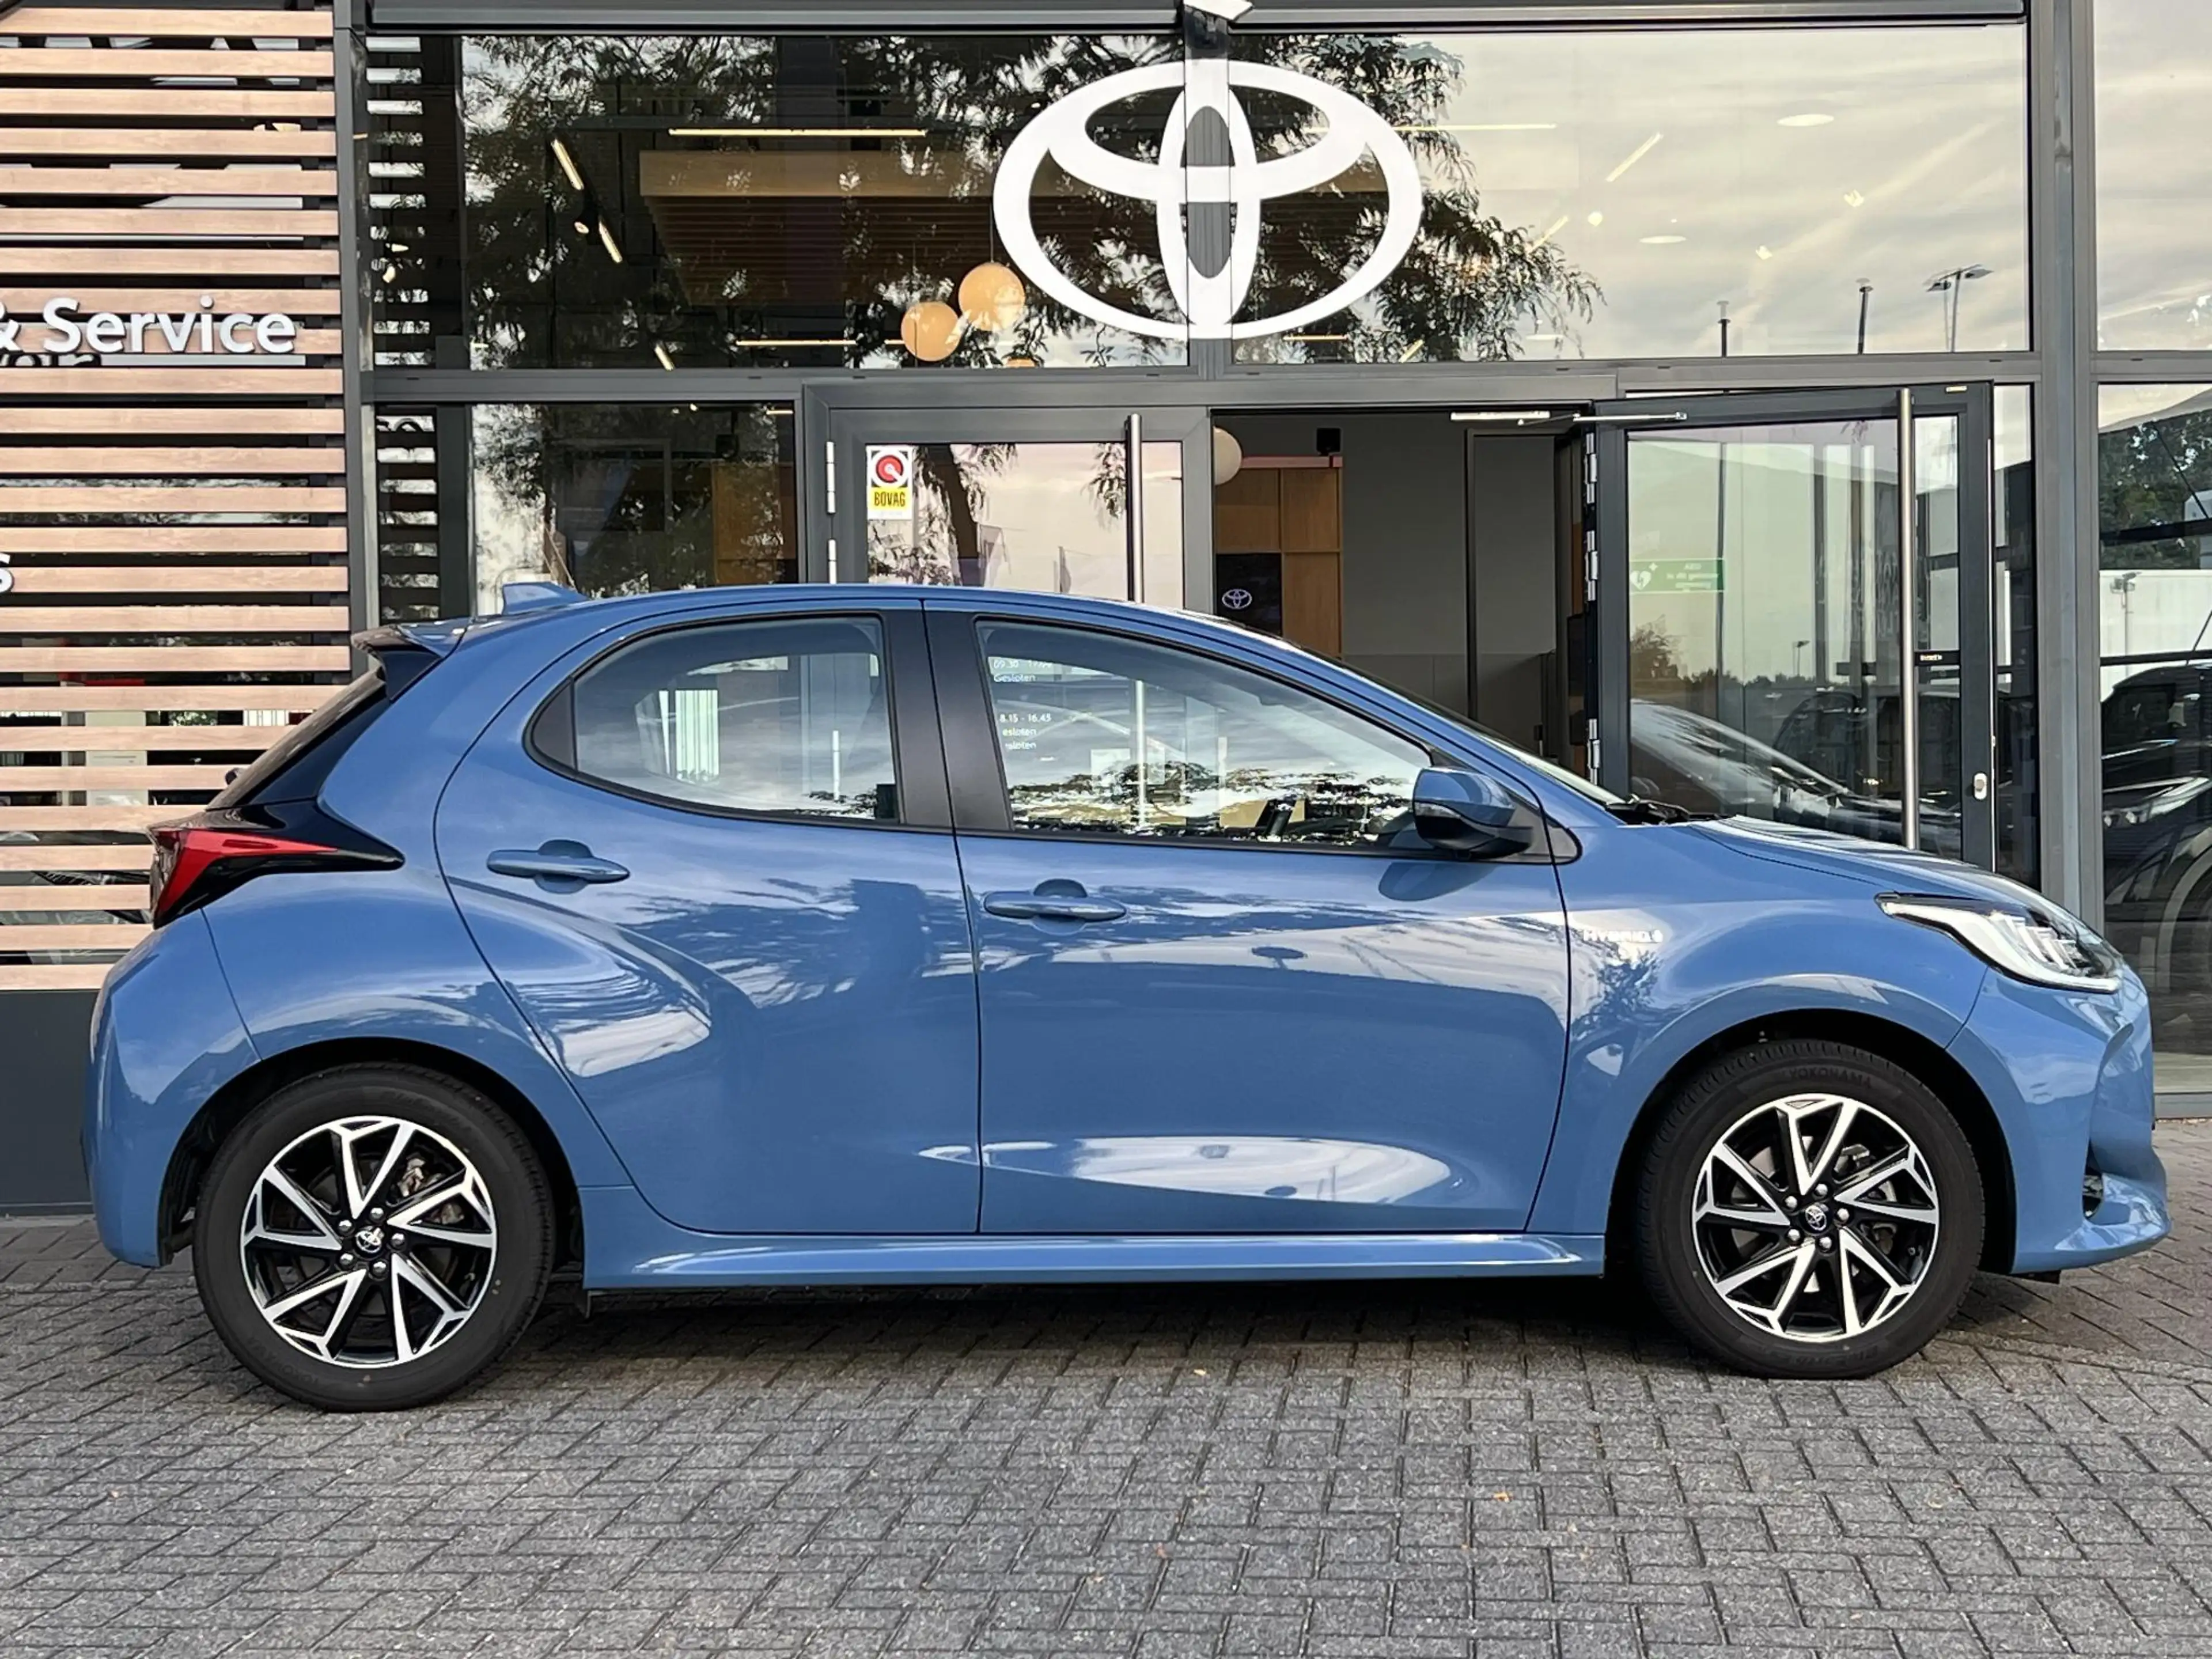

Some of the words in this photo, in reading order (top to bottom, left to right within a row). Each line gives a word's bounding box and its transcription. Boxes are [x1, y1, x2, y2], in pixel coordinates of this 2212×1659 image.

[43, 295, 296, 353] Service
[874, 491, 906, 507] BOVAG
[993, 673, 1036, 683] Gesloten
[999, 713, 1019, 723] 8.15
[1002, 727, 1037, 737] esloten
